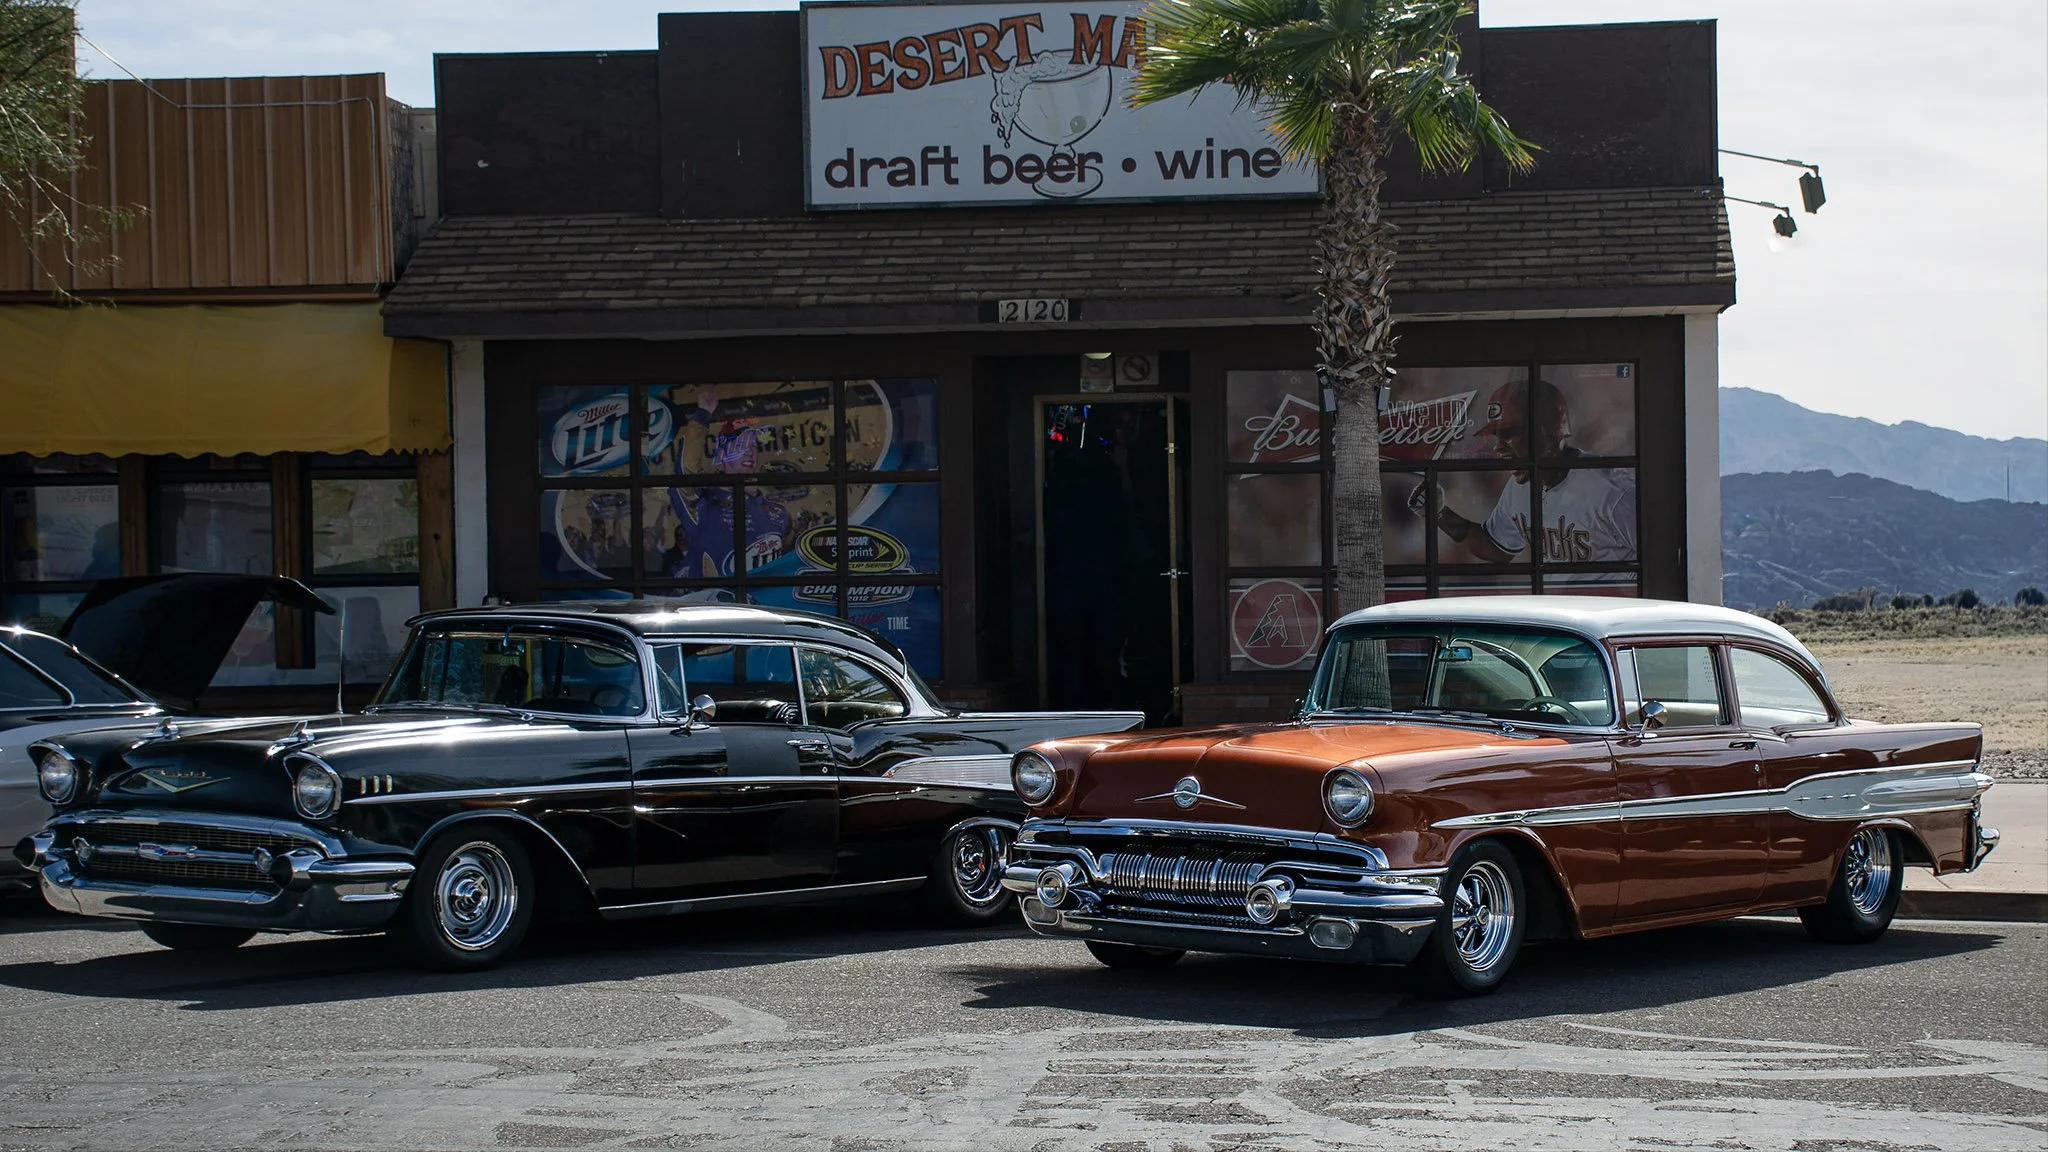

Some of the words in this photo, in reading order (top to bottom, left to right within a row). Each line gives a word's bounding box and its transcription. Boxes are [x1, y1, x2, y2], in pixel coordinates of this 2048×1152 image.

[819, 13, 1044, 99] DESERT
[824, 145, 959, 189] draft
[982, 144, 1104, 185] beer
[1154, 137, 1282, 180] wine
[1005, 300, 1065, 321] 2120
[577, 403, 622, 425] Miller
[1245, 414, 1464, 451] Bueiser
[825, 535, 870, 547] NASCAR
[831, 546, 874, 558] Sprint
[802, 584, 904, 595] CHAMPION
